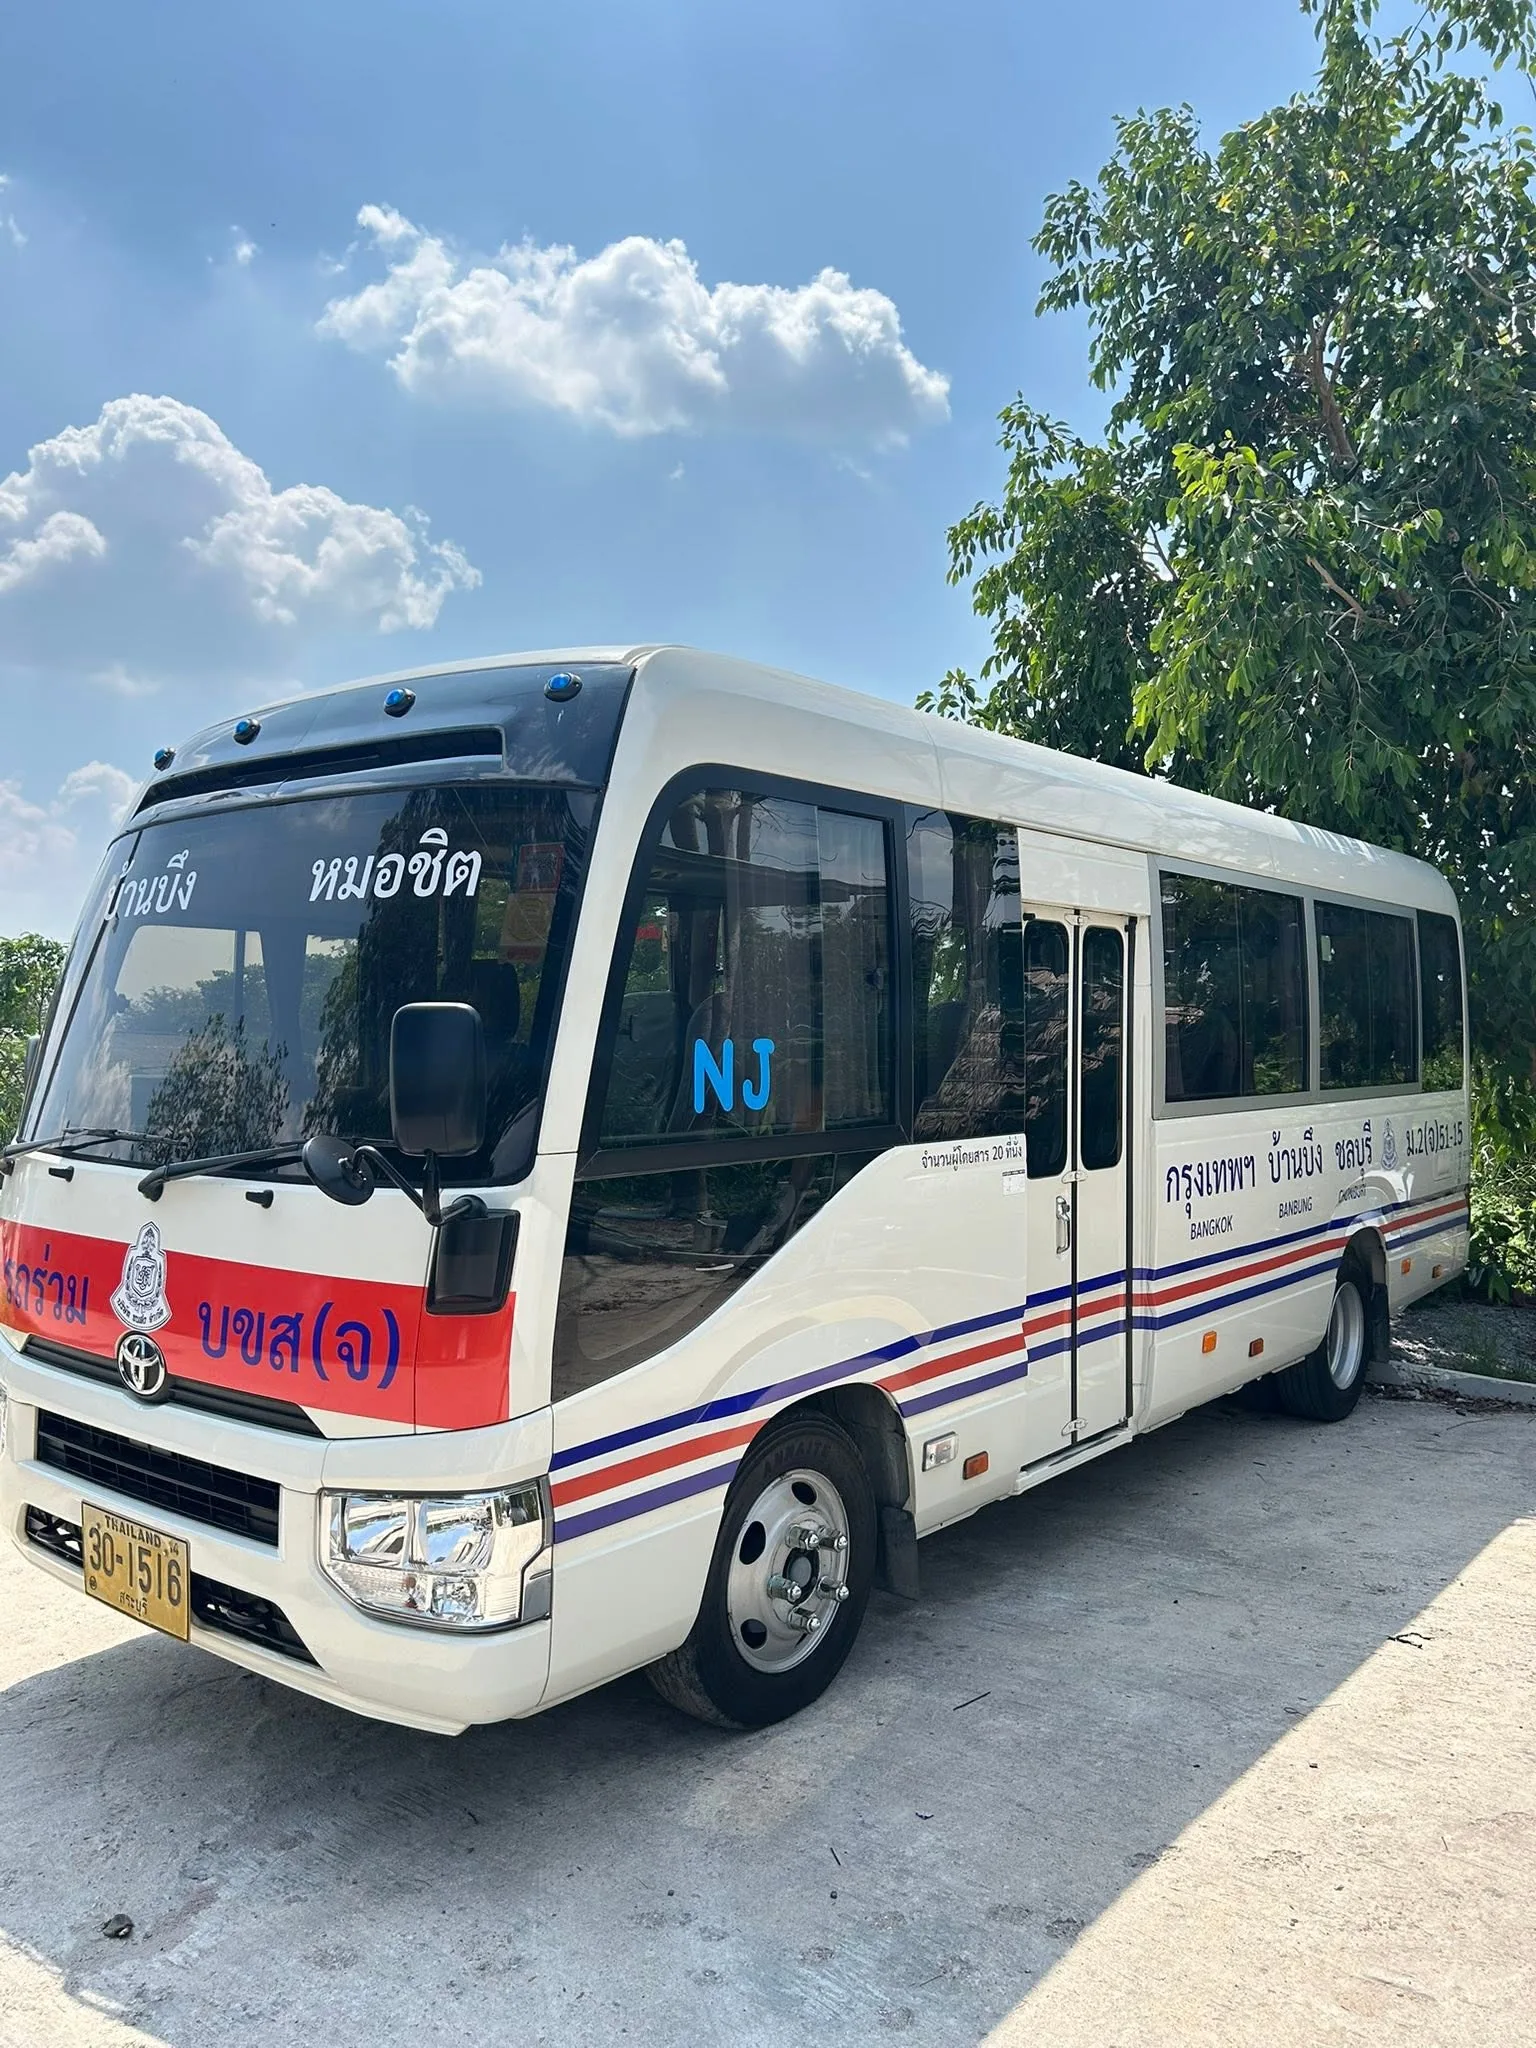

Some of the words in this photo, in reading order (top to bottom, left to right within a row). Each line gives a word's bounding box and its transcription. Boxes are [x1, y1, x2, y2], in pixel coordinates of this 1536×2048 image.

[103, 848, 198, 921] บ้านบึง
[308, 826, 482, 902] หมอชิต
[693, 1037, 775, 1114] NJ
[921, 1145, 990, 1172] จำนวนผู้โดยสาร
[992, 1145, 1003, 1161] 20
[1166, 1155, 1256, 1219] กรุงเทพฯ
[1268, 1126, 1323, 1184] บ้านบึง
[1335, 1118, 1373, 1182] ชลบุรี
[1190, 1215, 1234, 1240] BANGKOK
[1278, 1196, 1313, 1219] BANBUNG
[4, 1243, 90, 1325] รถร่วม
[198, 1301, 401, 1390] บขส(จ)
[89, 1526, 182, 1607] 30-1516
[104, 1514, 162, 1549] THAILAND
[119, 1591, 149, 1612] สระบุรี
